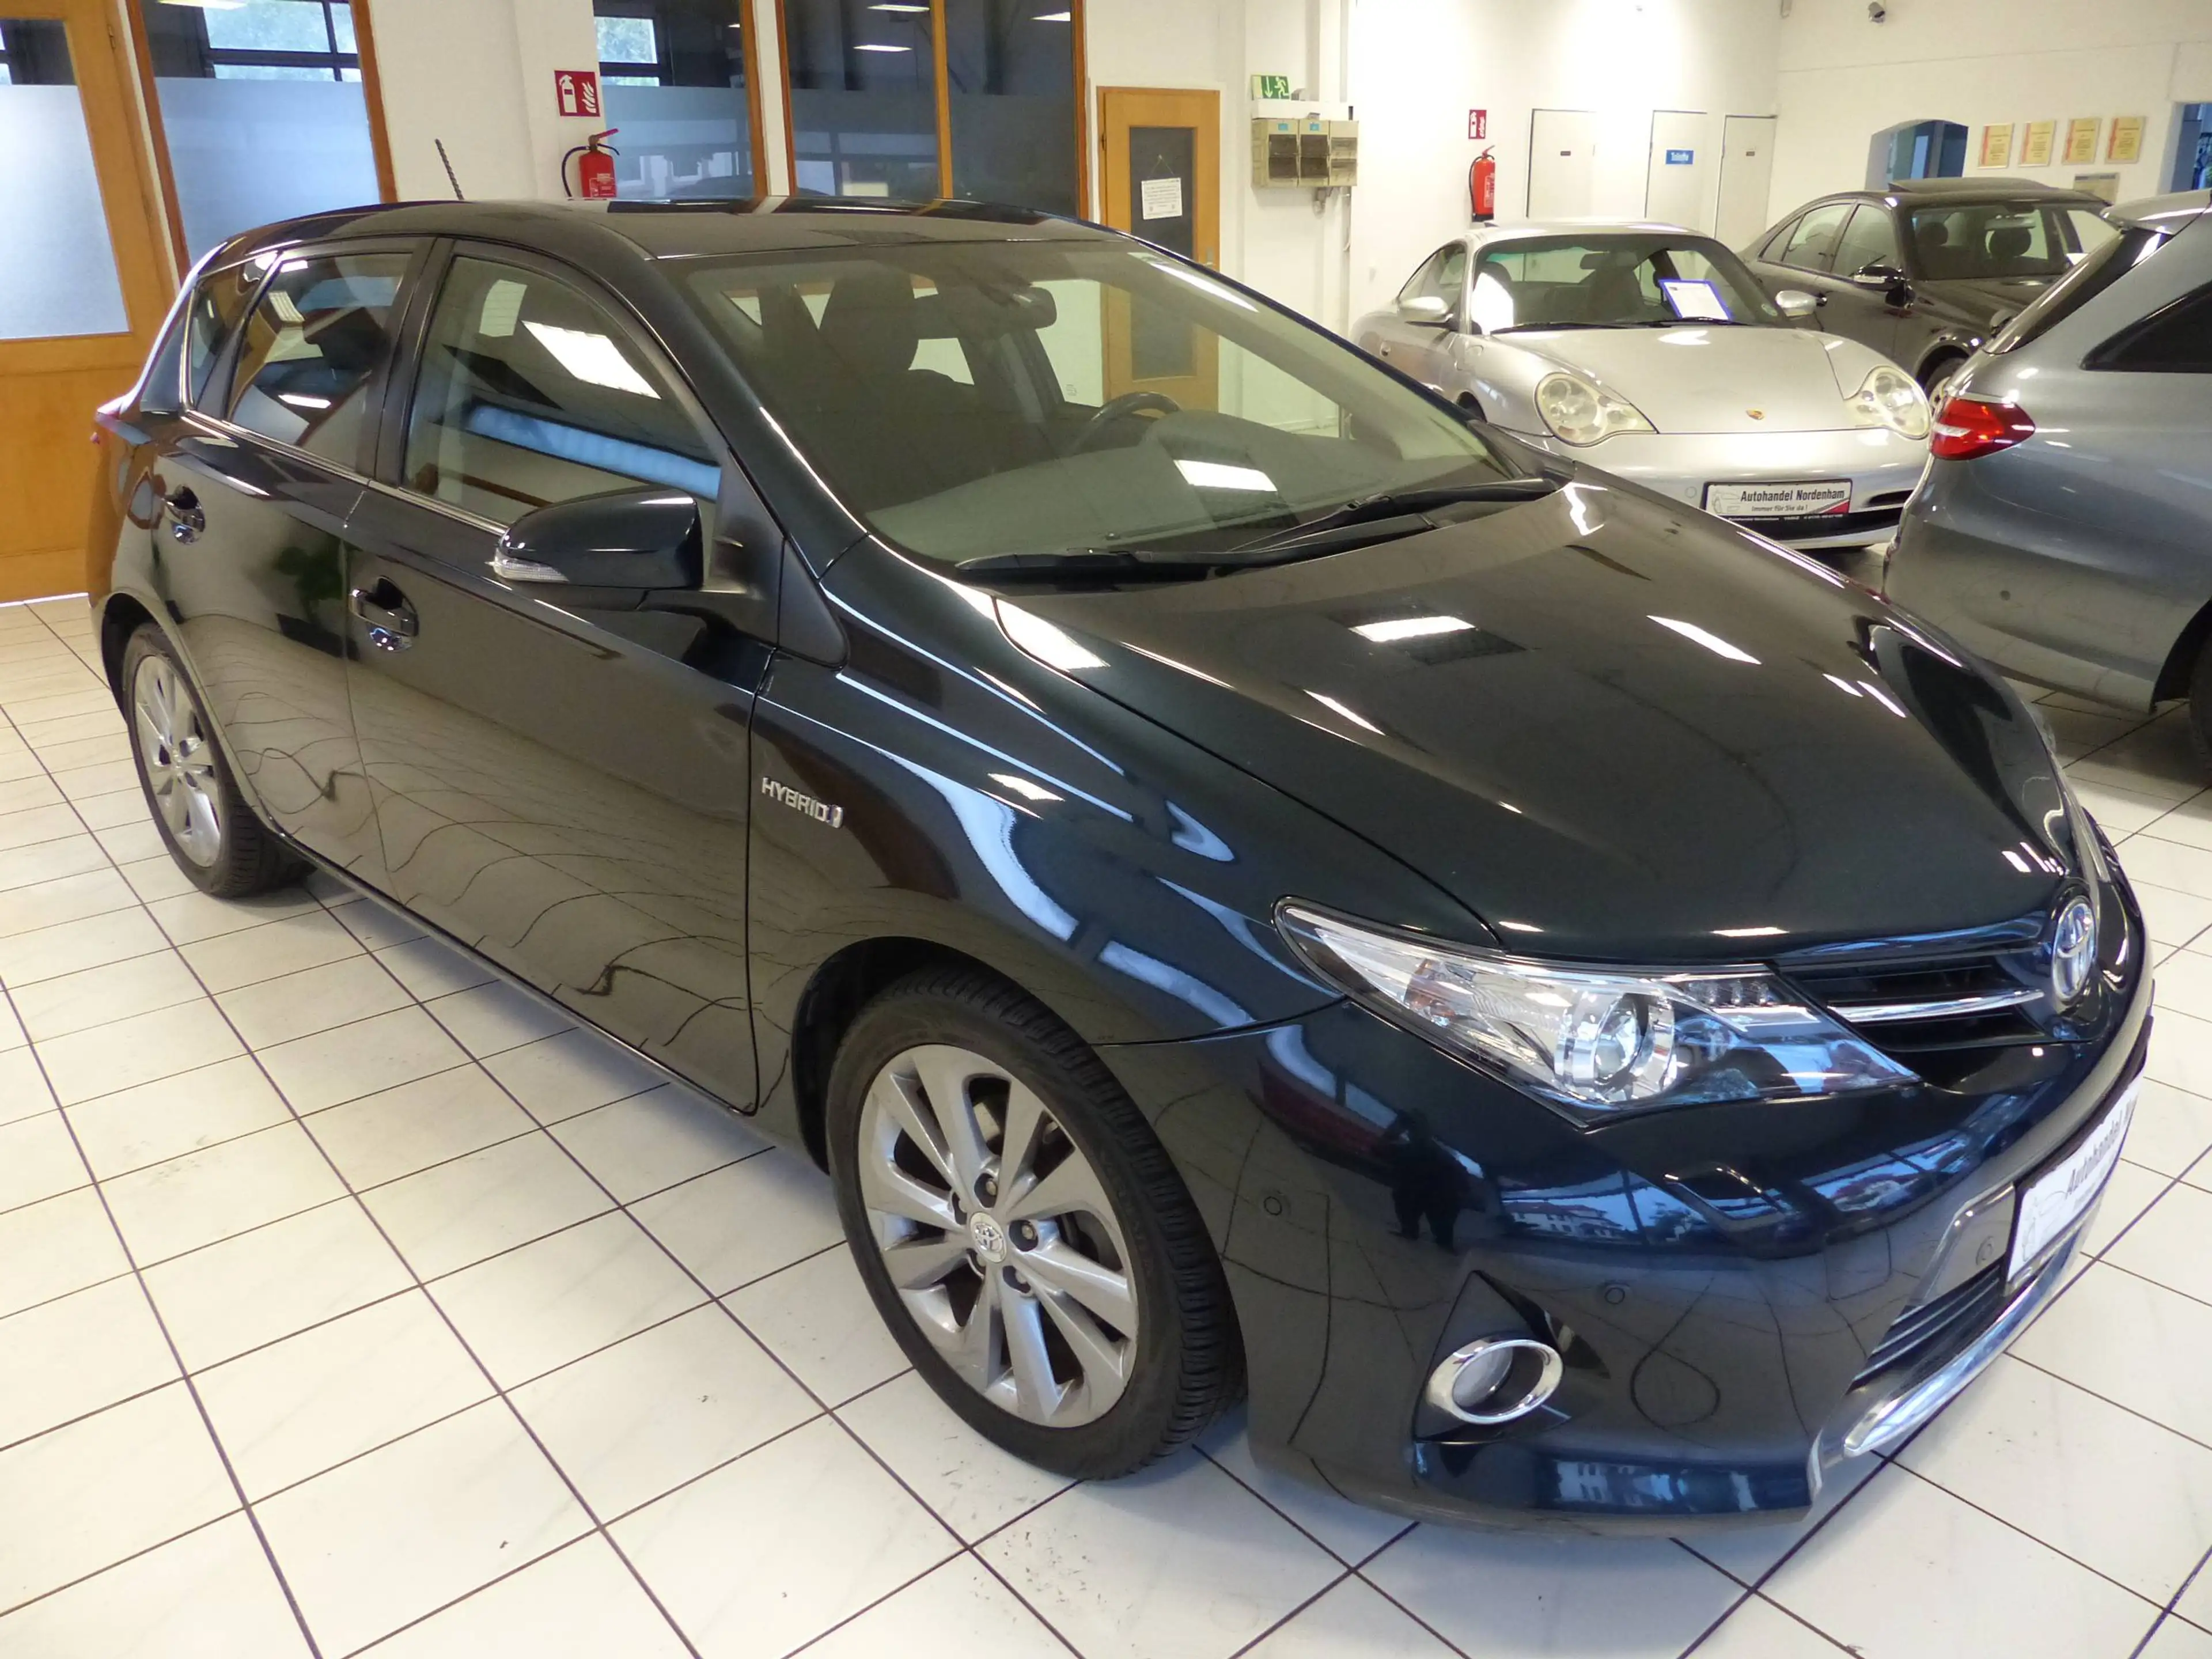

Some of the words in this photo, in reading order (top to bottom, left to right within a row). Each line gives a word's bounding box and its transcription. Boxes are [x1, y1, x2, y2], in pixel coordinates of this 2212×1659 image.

[1741, 491, 1793, 502] Autohandel
[1797, 489, 1844, 500] Nordenham
[762, 777, 831, 823] HYBRID
